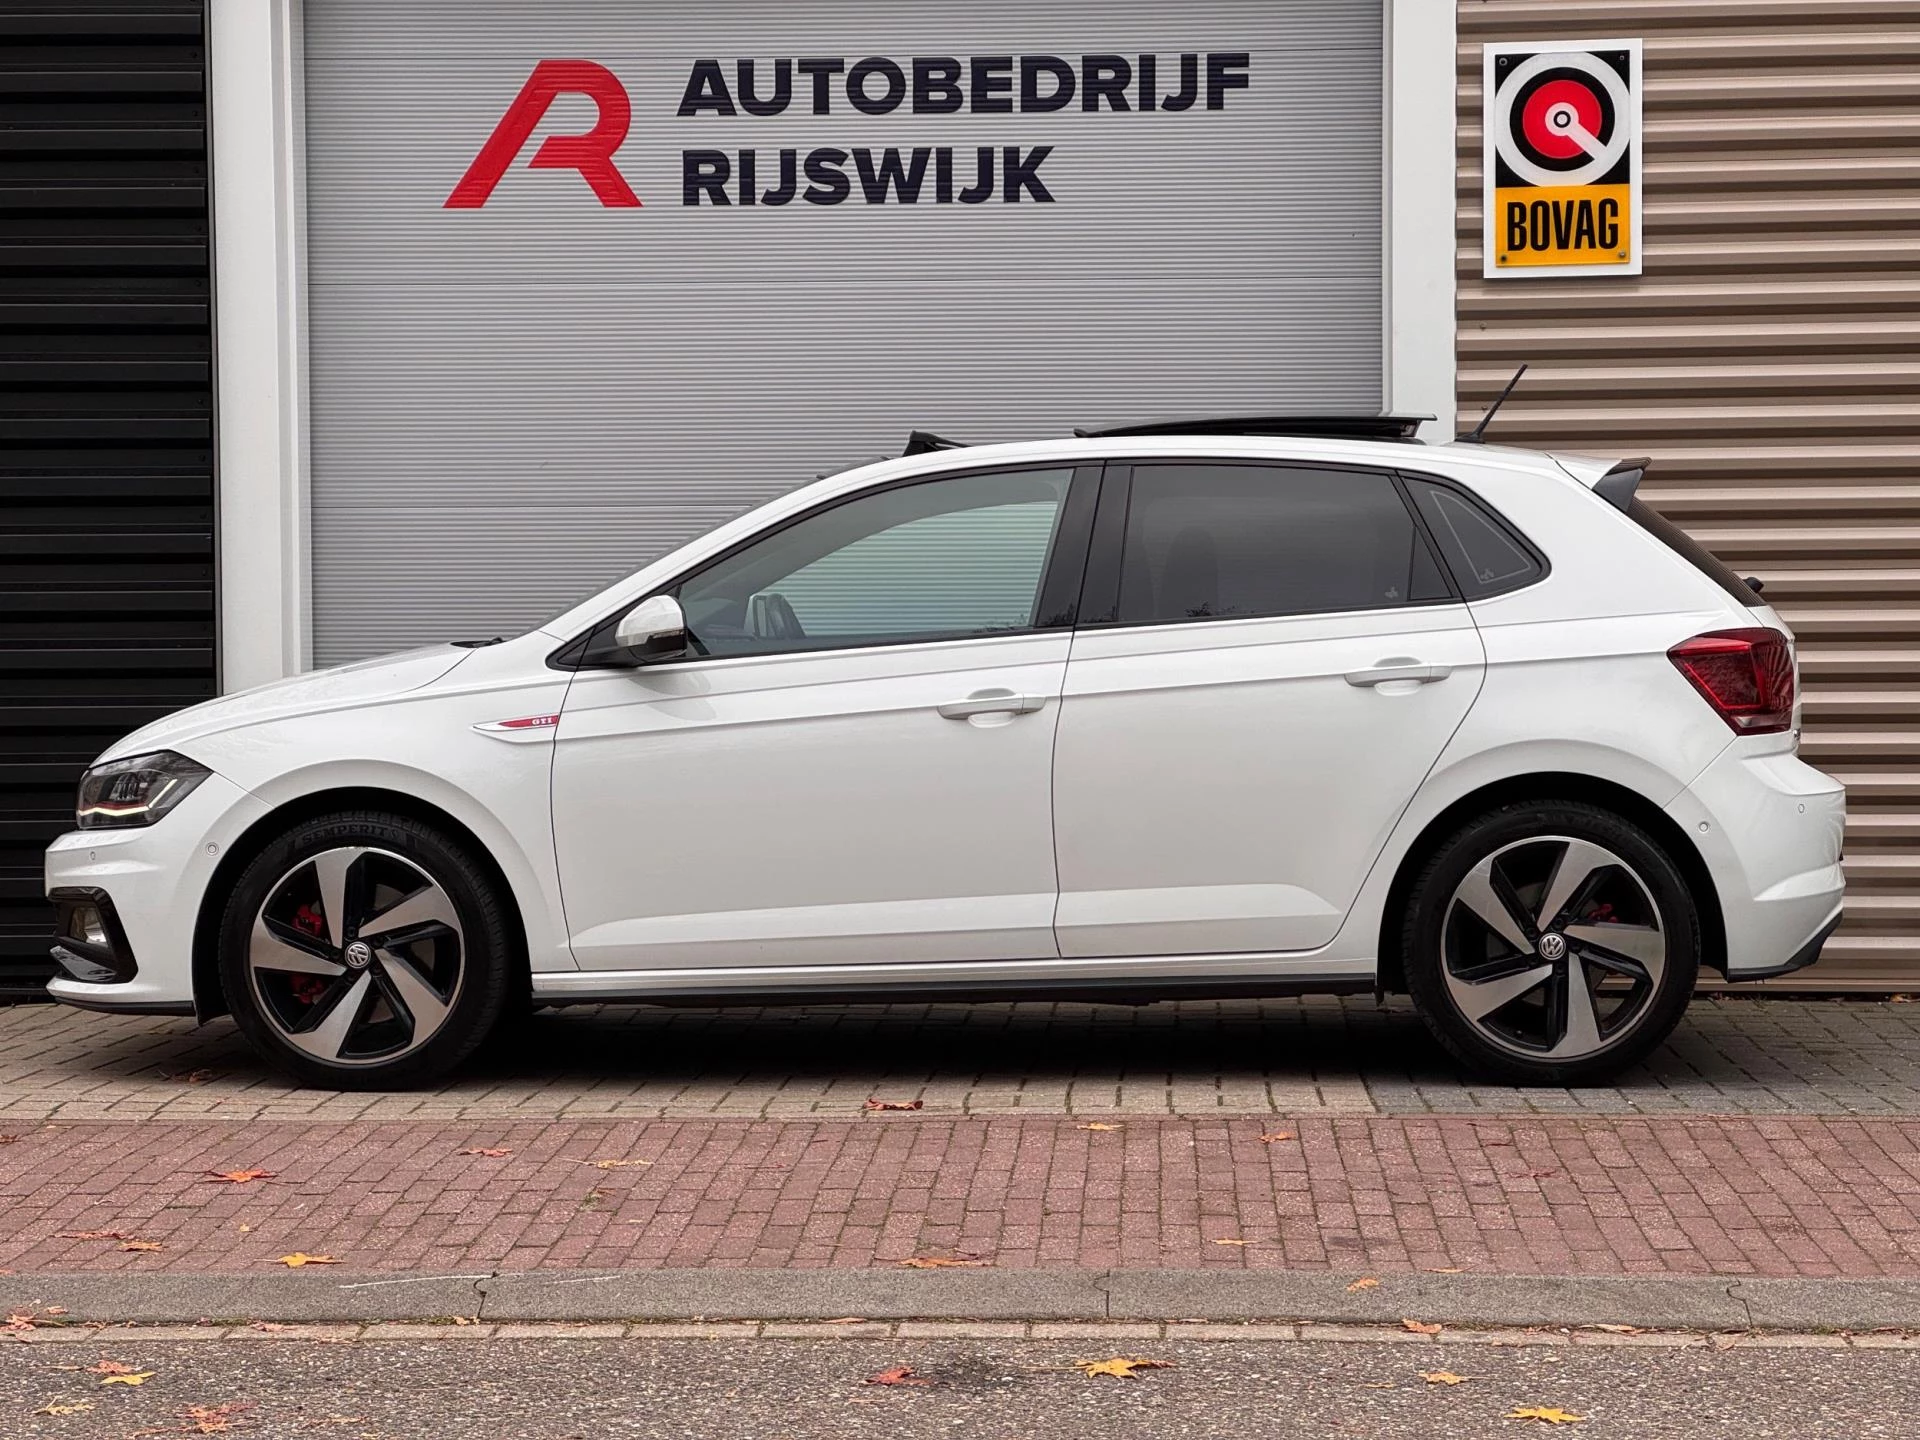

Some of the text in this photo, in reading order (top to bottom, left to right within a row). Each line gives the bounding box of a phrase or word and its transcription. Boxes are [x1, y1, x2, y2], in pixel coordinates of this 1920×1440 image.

[677, 52, 1250, 117] AUTOBEDRIJF
[682, 145, 1055, 207] RIJSWIJK
[1507, 198, 1619, 252] BOVAG
[531, 717, 552, 725] GTI
[302, 824, 388, 844] SEMPERIT
